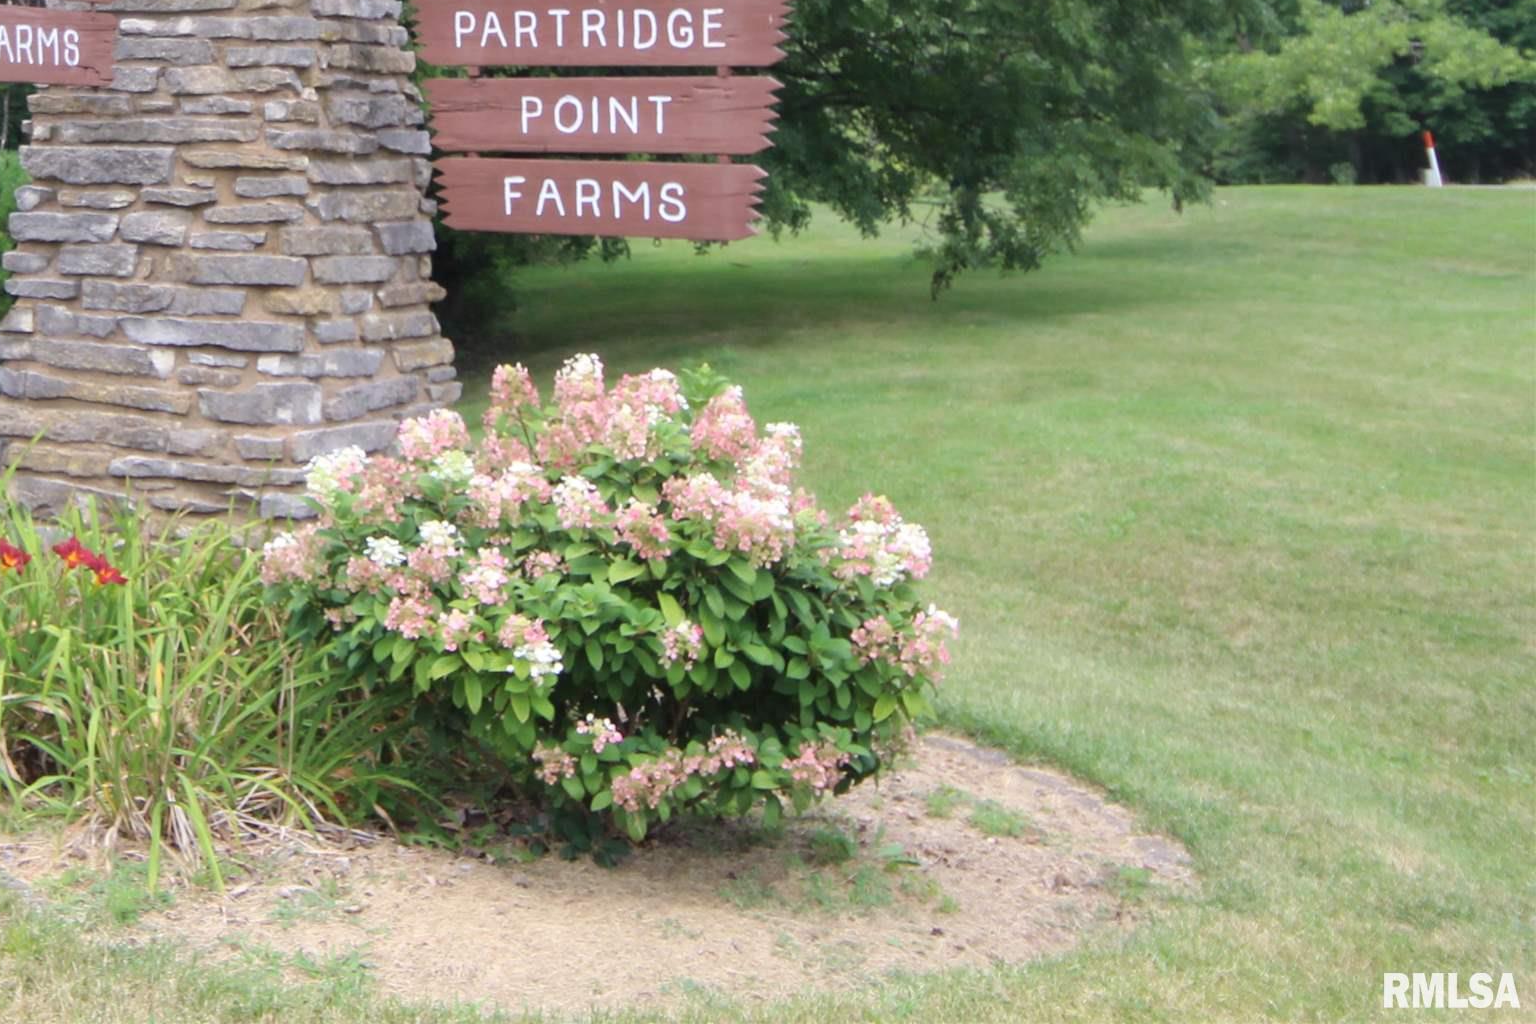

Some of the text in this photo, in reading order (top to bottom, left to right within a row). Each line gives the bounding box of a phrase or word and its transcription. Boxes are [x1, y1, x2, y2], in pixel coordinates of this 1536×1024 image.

[454, 8, 726, 49] PARTRIDGE
[521, 95, 672, 134] POINT
[504, 176, 686, 222] FARMS
